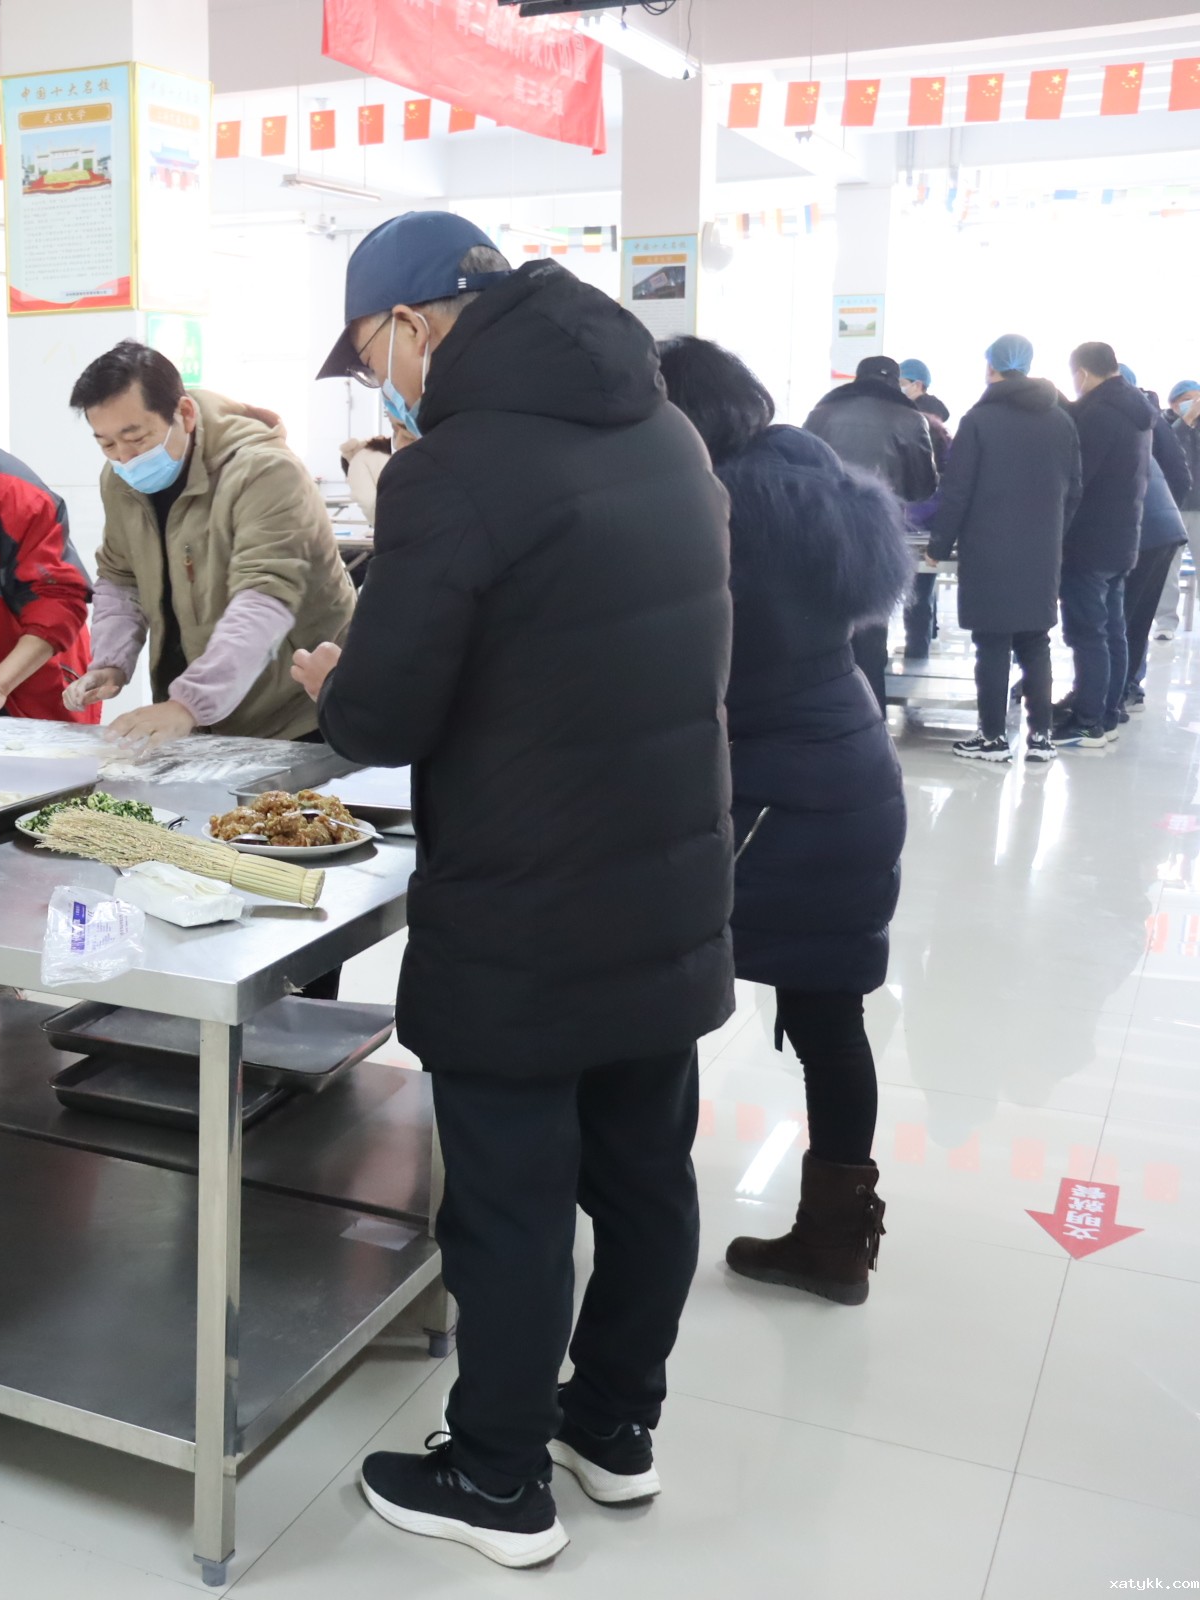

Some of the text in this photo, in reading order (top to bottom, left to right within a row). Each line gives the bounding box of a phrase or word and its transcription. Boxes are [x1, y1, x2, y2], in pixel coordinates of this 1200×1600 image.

[21, 78, 111, 102] 中国十大名校
[43, 109, 87, 124] 武汉大学
[1062, 1184, 1106, 1240] 文明就餐
